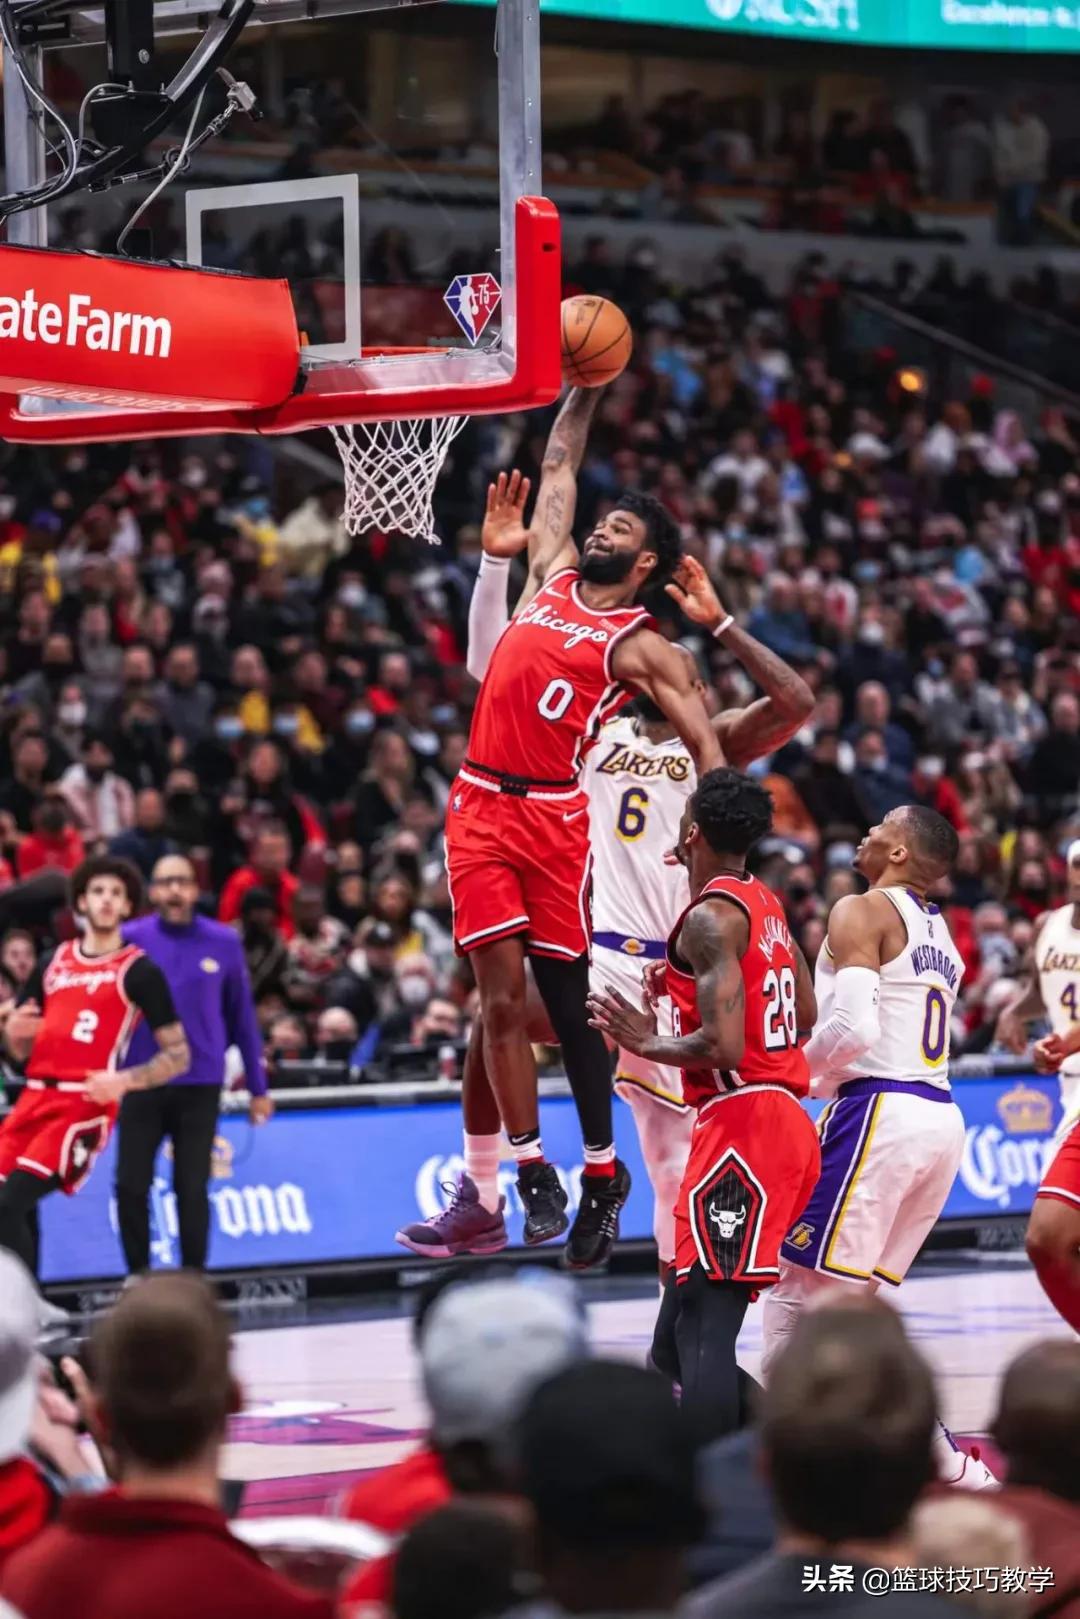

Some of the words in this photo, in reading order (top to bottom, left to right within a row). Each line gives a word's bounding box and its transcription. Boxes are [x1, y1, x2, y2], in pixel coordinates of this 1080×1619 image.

[478, 284, 490, 305] 75
[516, 603, 608, 649] Chicago
[537, 677, 575, 721] 0
[596, 742, 690, 782] LAKERS
[616, 786, 650, 841] 6
[72, 1009, 99, 1044] 2
[763, 966, 798, 1051] 28
[920, 986, 947, 1066] 0
